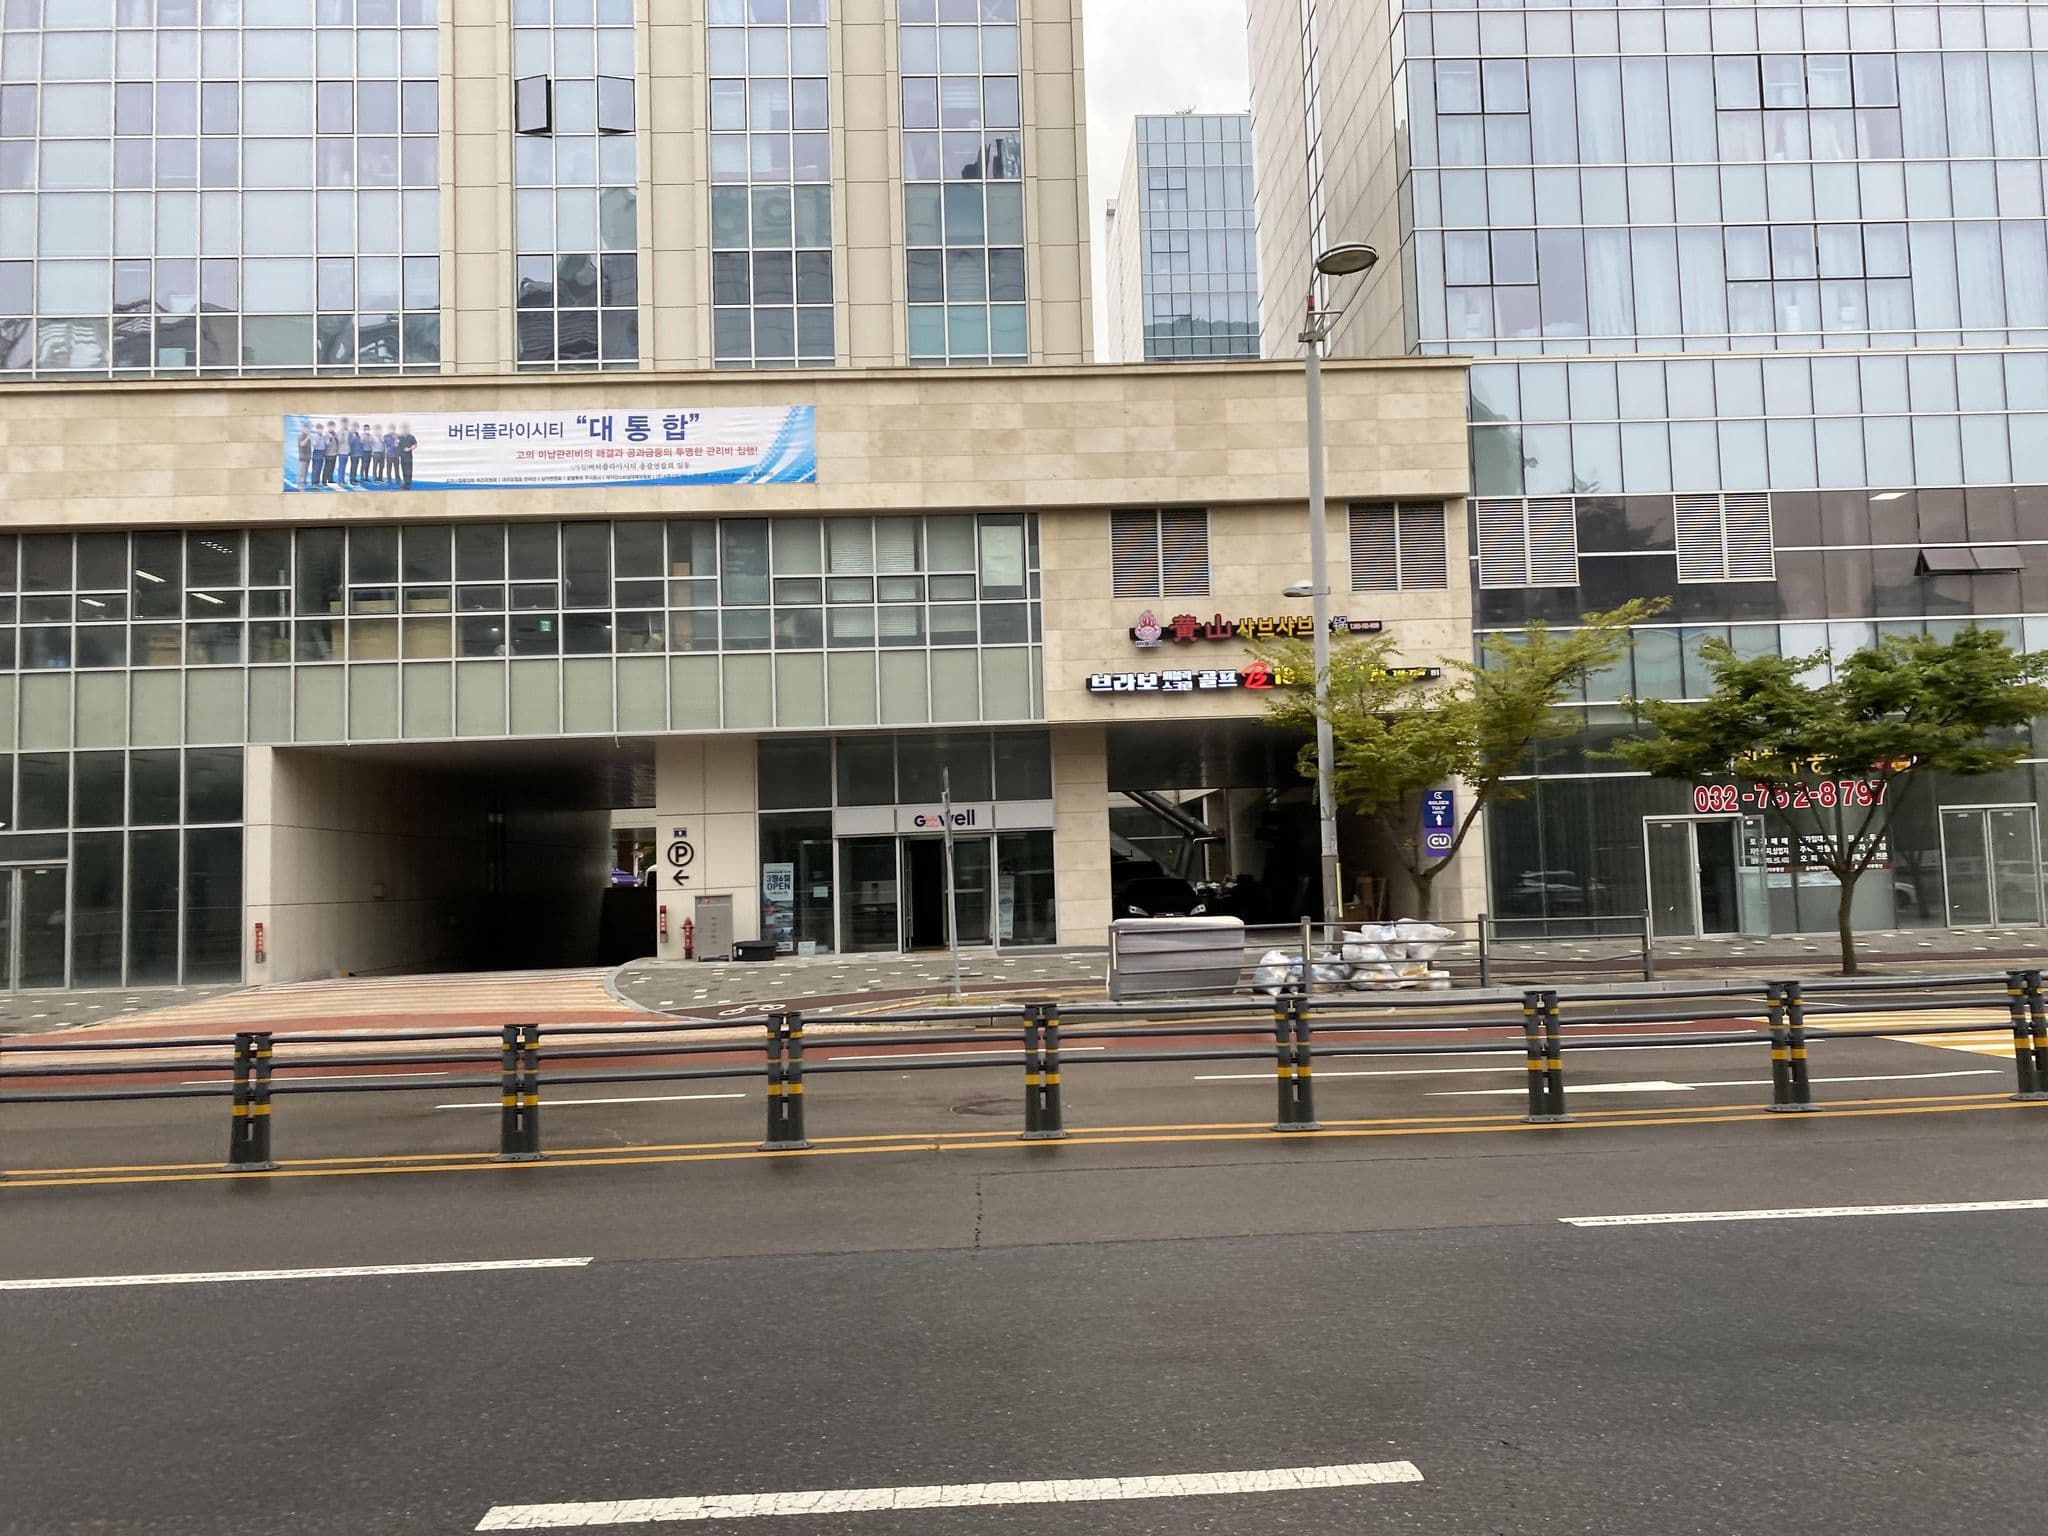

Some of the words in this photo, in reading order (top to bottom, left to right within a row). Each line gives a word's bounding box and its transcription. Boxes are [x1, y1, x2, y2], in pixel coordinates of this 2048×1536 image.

[448, 421, 564, 441] 버터플라이시티
[538, 449, 593, 459] 미납관리비의
[596, 448, 624, 458] 해결과
[675, 446, 702, 457] 투명한
[706, 446, 734, 456] 관리비
[1236, 615, 1314, 638] 샤브샤브
[1090, 673, 1159, 692] 브라보
[1197, 670, 1238, 689] 골프
[1431, 837, 1447, 846] CU
[766, 882, 791, 891] OPEN
